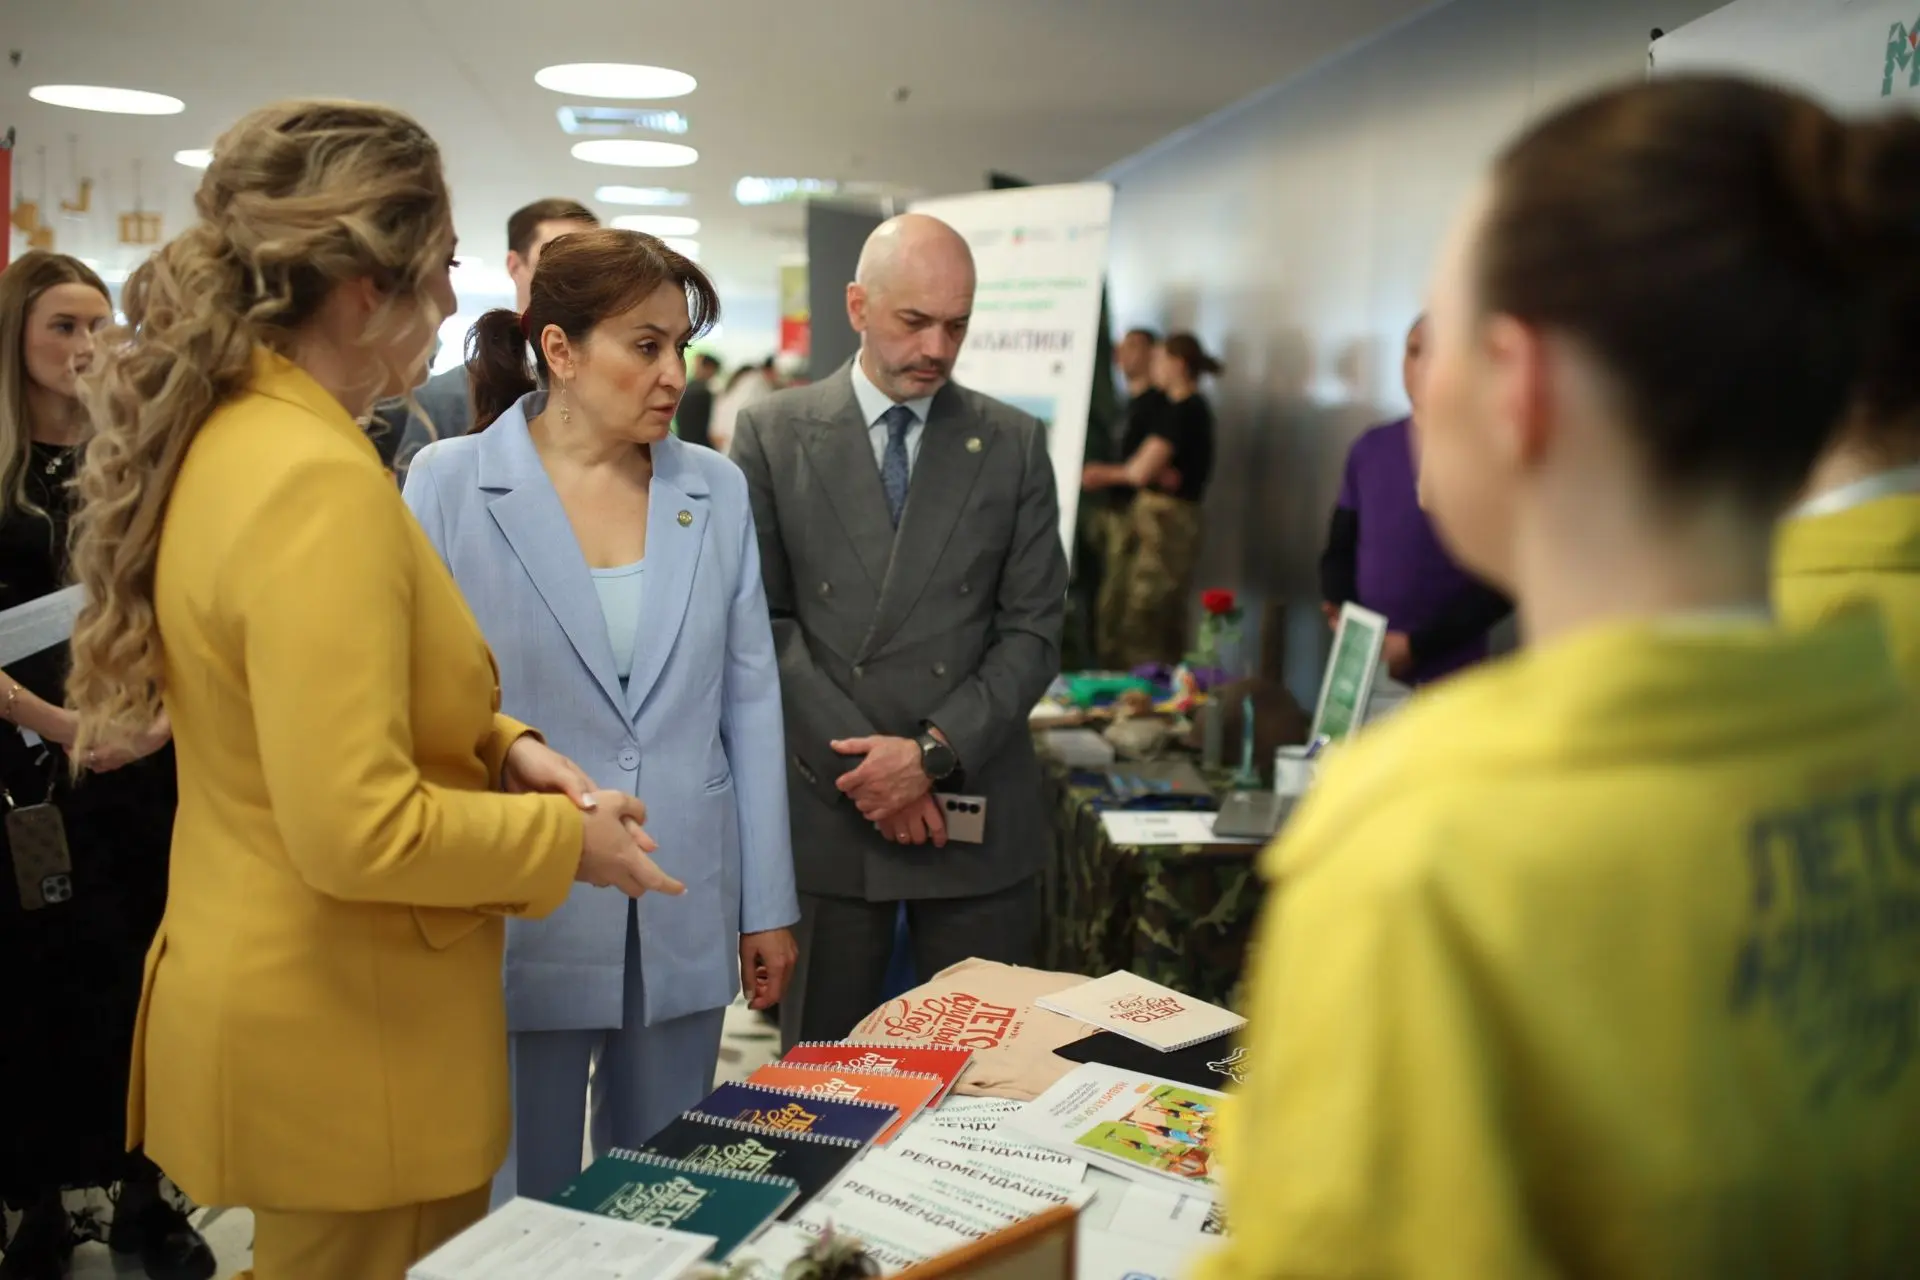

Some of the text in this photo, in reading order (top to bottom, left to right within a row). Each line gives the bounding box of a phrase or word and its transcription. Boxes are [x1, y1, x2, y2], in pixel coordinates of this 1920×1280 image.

[958, 1002, 1017, 1050] ЛЕТО
[1132, 1003, 1186, 1022] ЛЕТО
[900, 1148, 1069, 1205] РЕКОМЕНДАЦИИ
[843, 1179, 988, 1241] РЕКОМЕНДАЦИ
